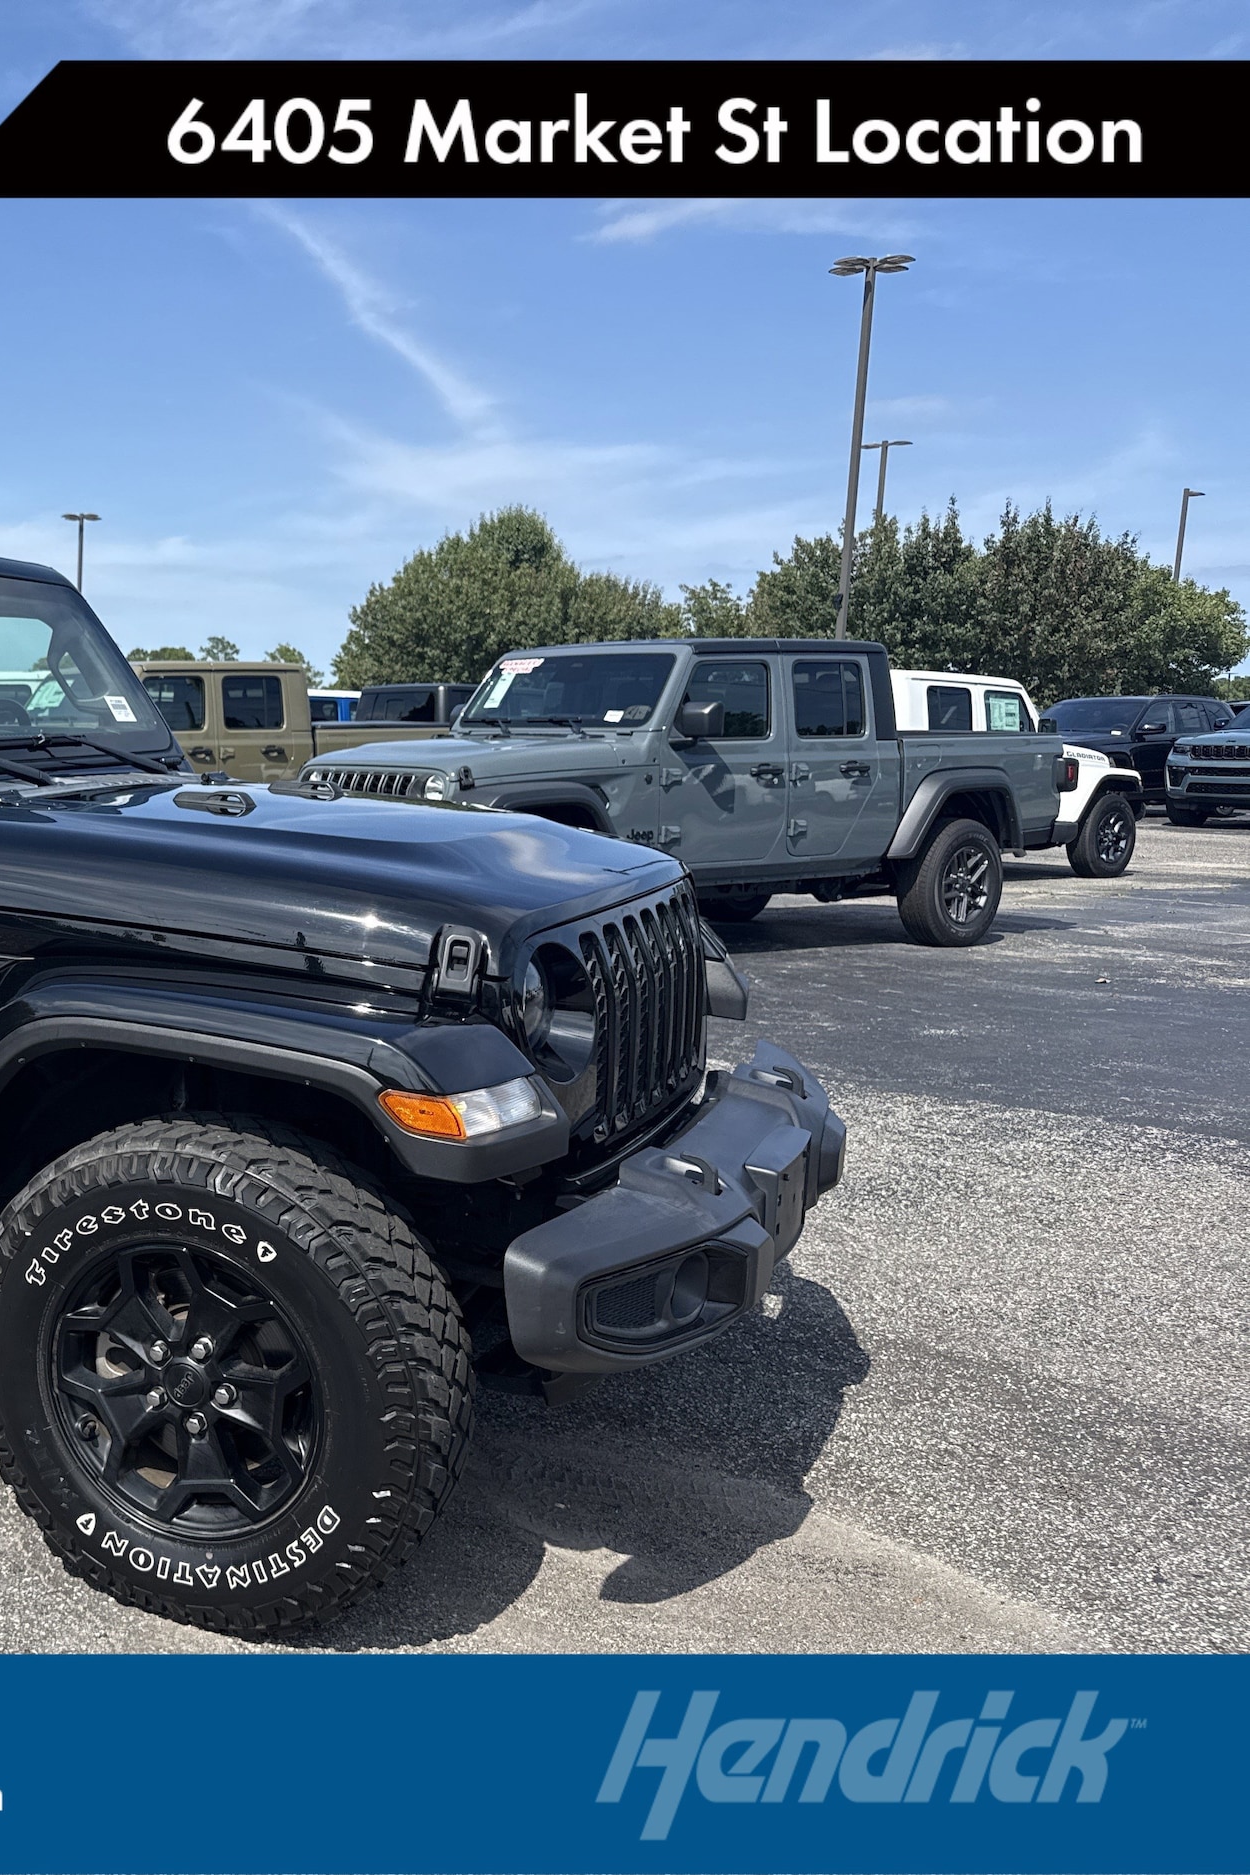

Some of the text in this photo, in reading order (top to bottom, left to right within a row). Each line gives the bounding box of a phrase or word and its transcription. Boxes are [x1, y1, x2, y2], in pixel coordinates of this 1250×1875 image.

[626, 828, 654, 843] Jeep
[25, 1199, 248, 1286] Firestone
[101, 1504, 341, 1590] DESTINATION
